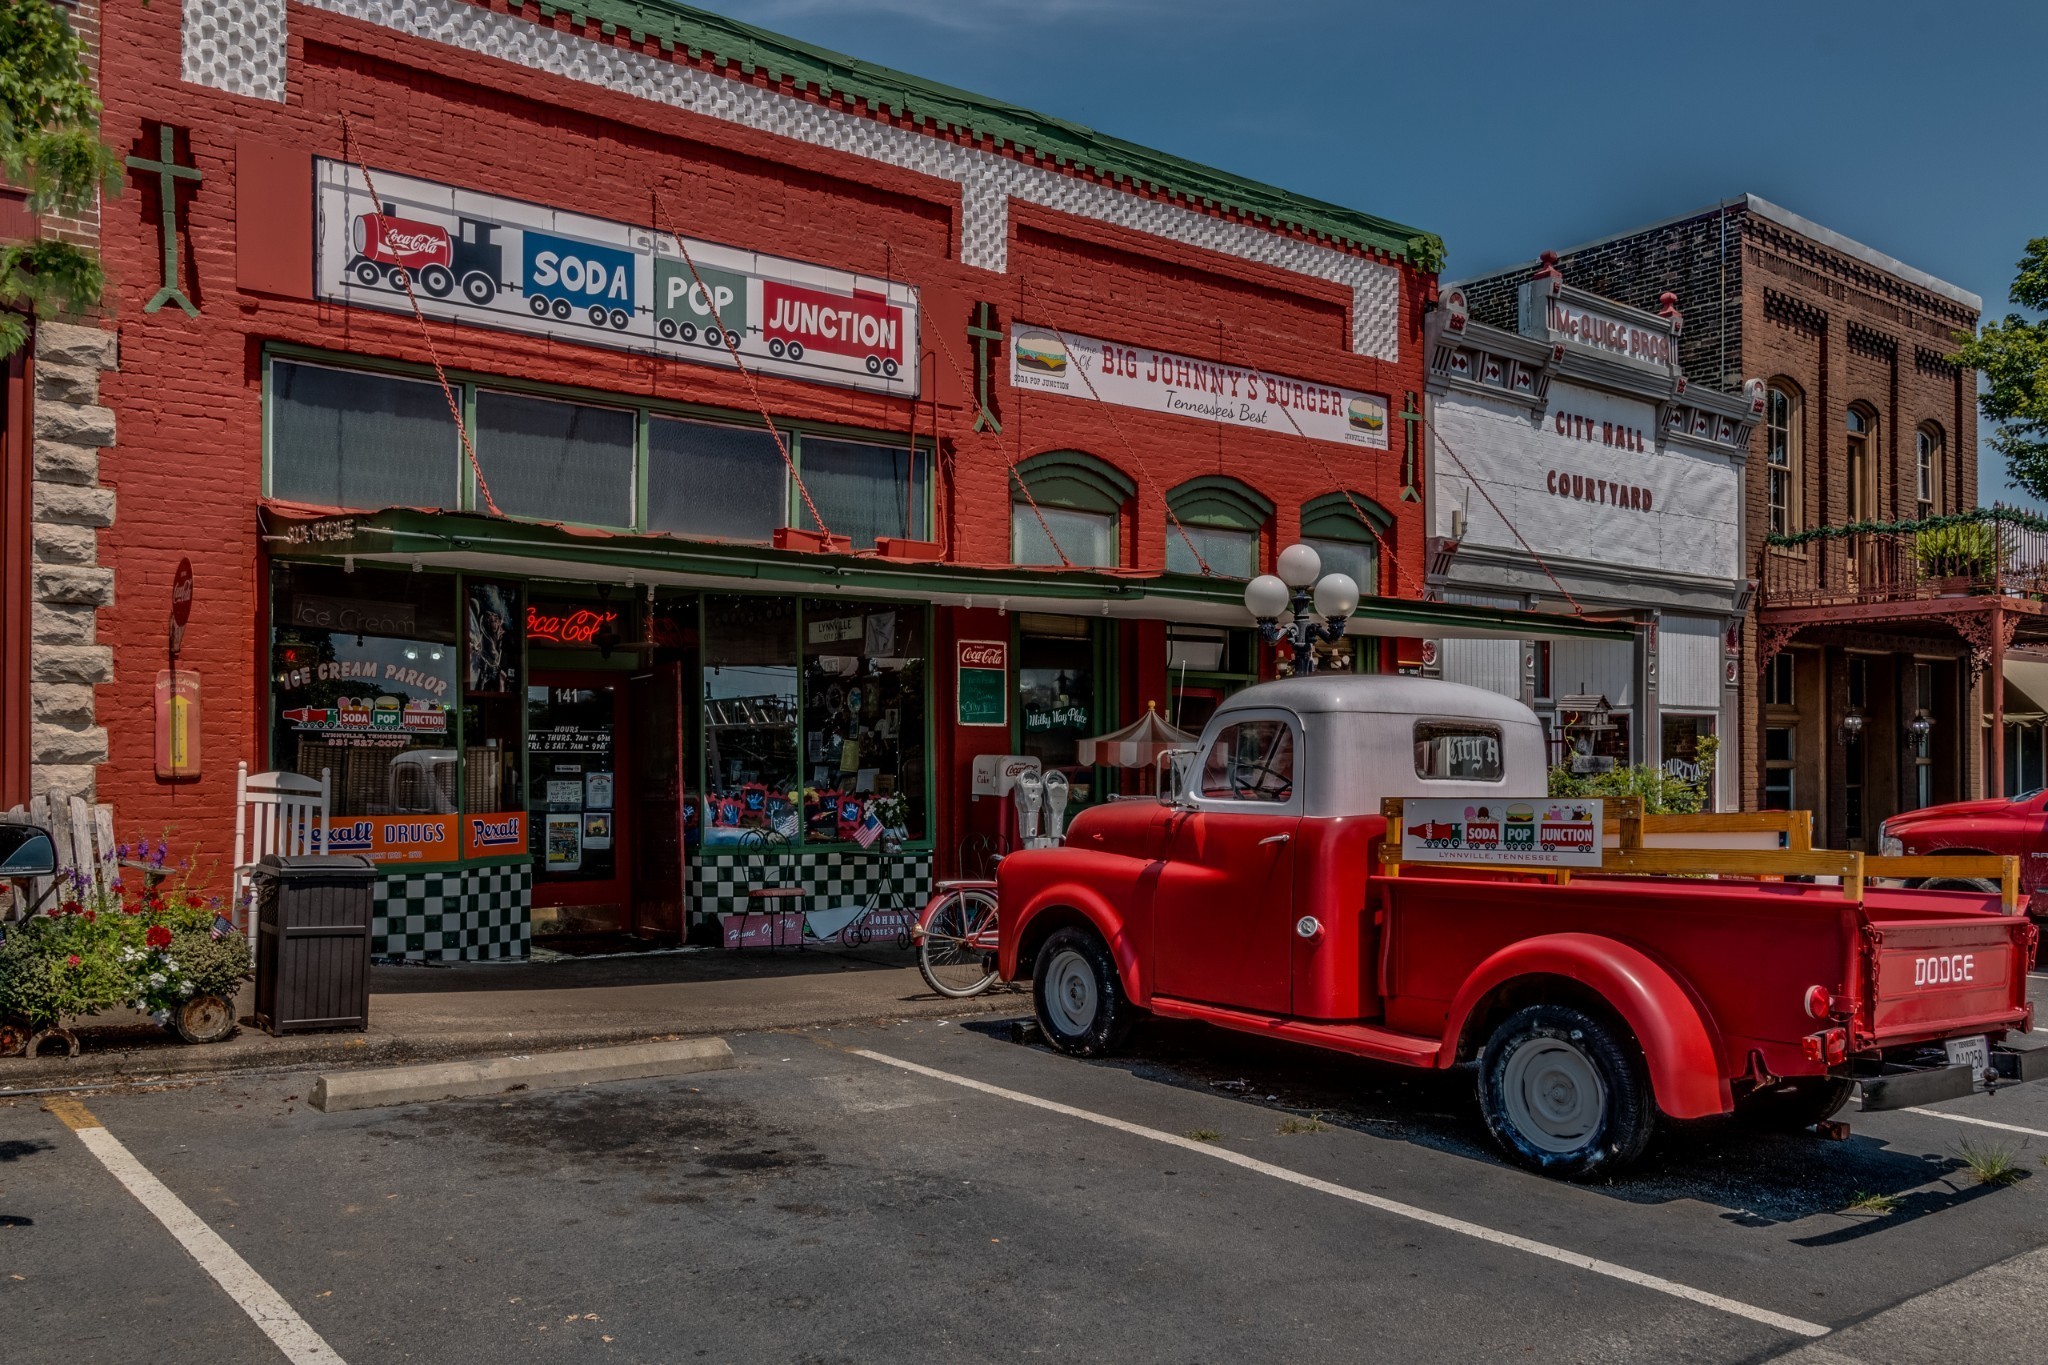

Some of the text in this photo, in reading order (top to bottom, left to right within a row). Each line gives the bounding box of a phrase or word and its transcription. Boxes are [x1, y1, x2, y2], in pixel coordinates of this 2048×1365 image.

[385, 228, 440, 254] Coca-Cola
[533, 251, 897, 350] SODA POP JUNCTION
[1073, 339, 1097, 354] Home
[1631, 329, 1669, 360] BROS
[1079, 354, 1092, 371] Of
[1014, 374, 1070, 390] SODA POP JUNCTION
[1101, 344, 1344, 417] BIG JOHNNY'S BURGER
[1165, 390, 1268, 424] Tennessee's Best
[1555, 411, 1645, 453] CITY HALL
[1547, 470, 1653, 513] COURTYARD
[296, 601, 416, 634] Ice Cream
[526, 606, 617, 642] oca-Col
[962, 646, 1002, 664] Coca-Cola
[283, 661, 447, 696] ICE CREAM PARLOR
[555, 688, 578, 703] 141
[343, 713, 444, 725] SODA POP JUNCTION
[554, 725, 580, 733] HOURS
[1029, 708, 1051, 729] Milky
[1052, 709, 1067, 726] Way
[384, 823, 445, 843] DRUGS
[473, 818, 520, 847] Rexall
[1468, 827, 1593, 842] SODA POP JUNCTION
[1439, 851, 1559, 861] LYNNVILLE, TENNESSEE
[1914, 954, 1974, 986] DODGE
